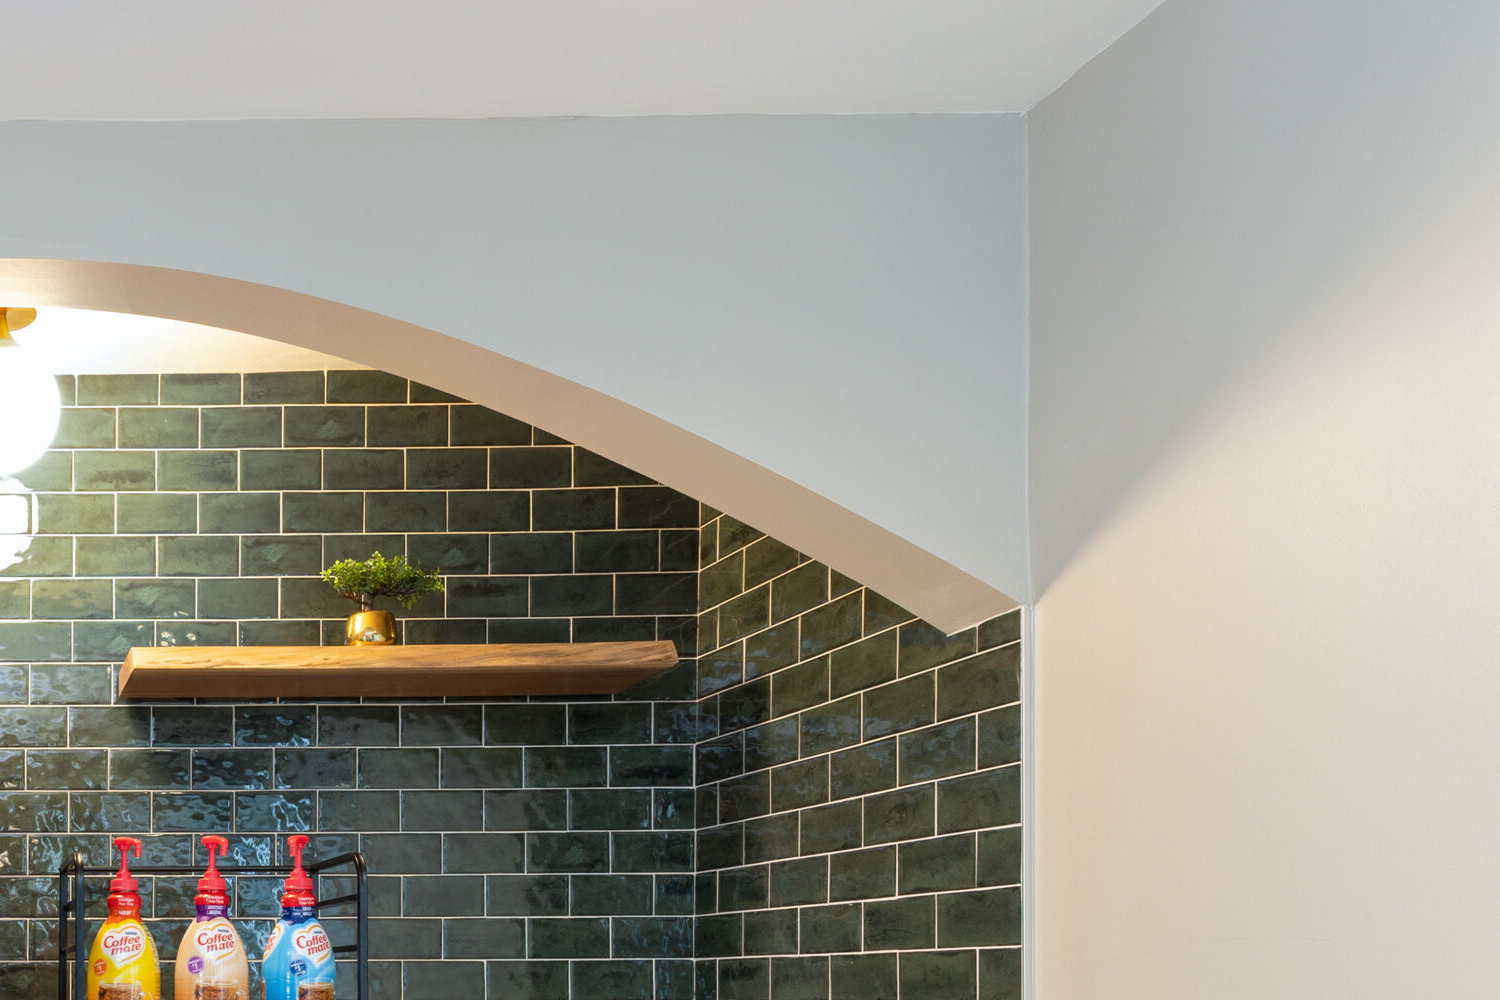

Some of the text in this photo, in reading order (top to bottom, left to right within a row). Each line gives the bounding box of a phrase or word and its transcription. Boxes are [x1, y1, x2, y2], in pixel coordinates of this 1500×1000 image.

[103, 935, 141, 949] Coffee
[197, 932, 233, 946] Coffee
[296, 935, 328, 949] Coffee
[111, 943, 141, 956] mate
[206, 941, 235, 952] mate
[308, 941, 330, 955] mate
